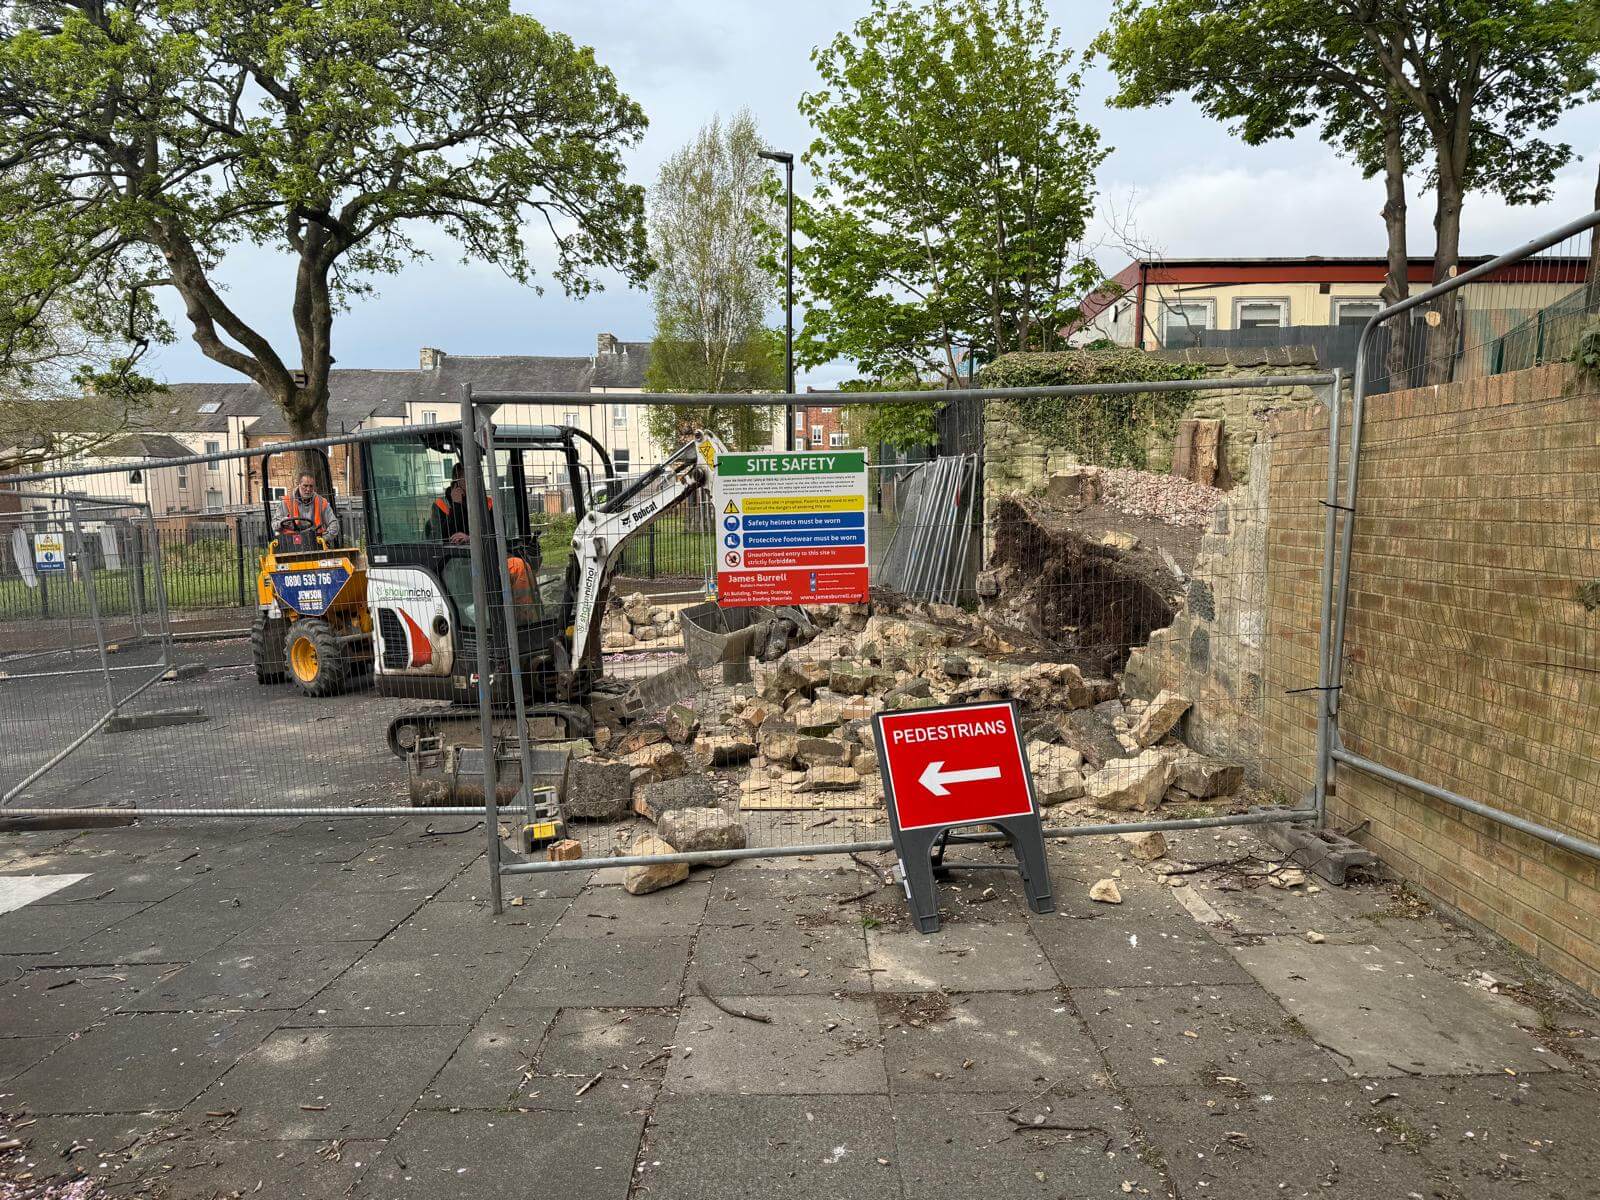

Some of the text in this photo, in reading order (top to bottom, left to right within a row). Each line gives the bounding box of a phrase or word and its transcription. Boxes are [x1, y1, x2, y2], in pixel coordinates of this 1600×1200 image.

[747, 457, 835, 472] SITE SAFETY
[632, 500, 658, 522] Bobcat
[284, 573, 332, 587] 0800 539 766
[728, 573, 787, 583] James Burrell
[298, 590, 322, 600] JEWSON
[893, 720, 1007, 744] PEDESTRIANS
